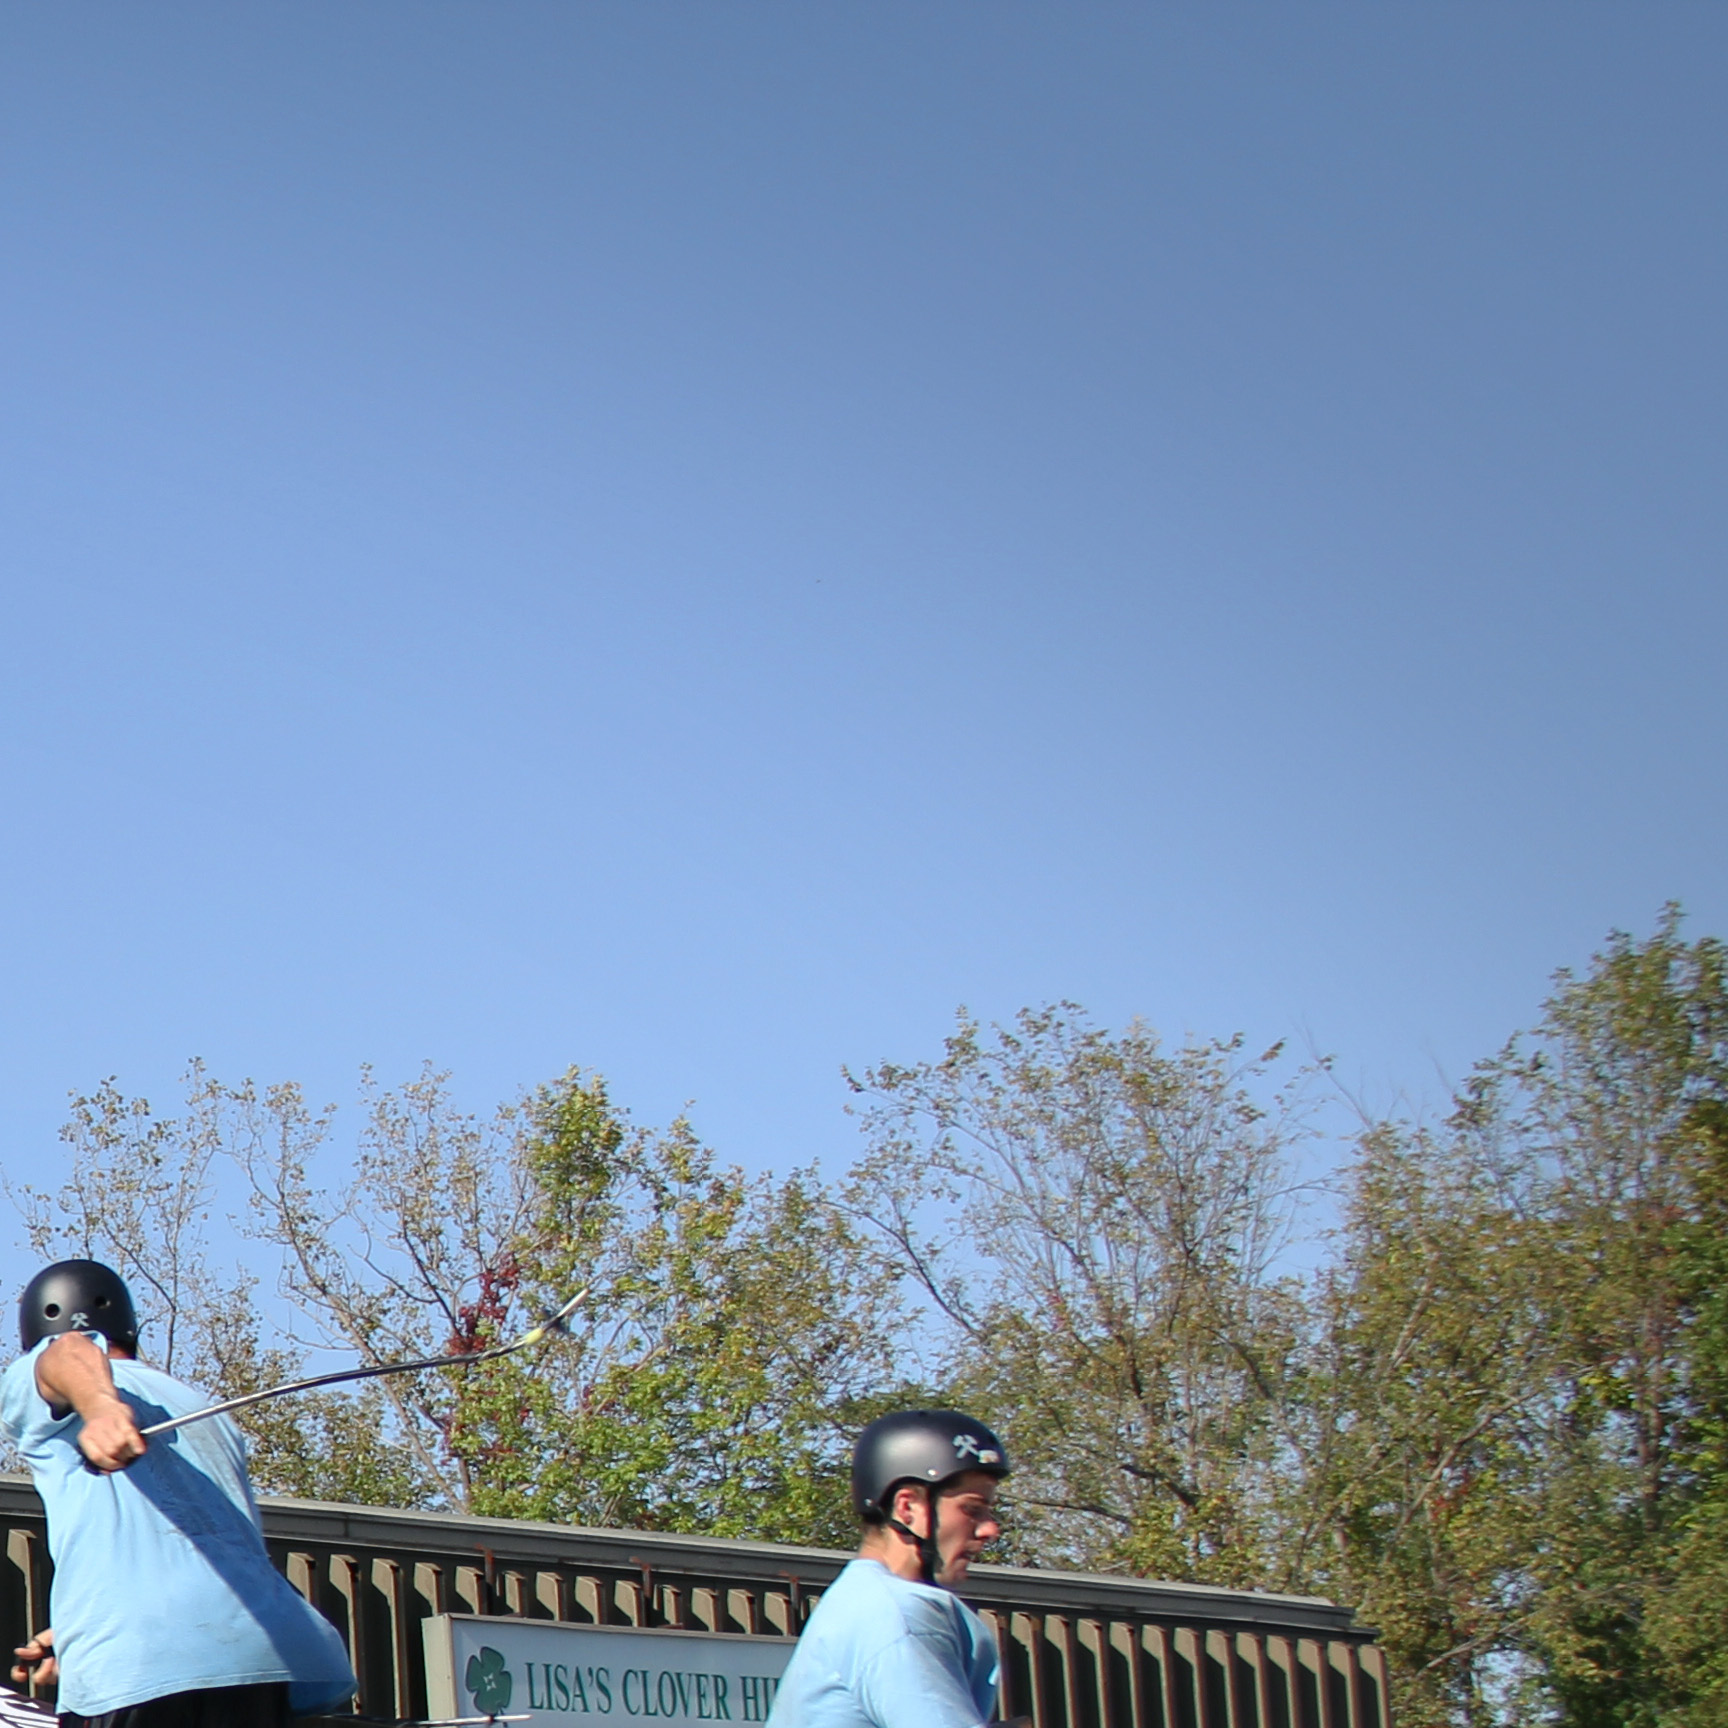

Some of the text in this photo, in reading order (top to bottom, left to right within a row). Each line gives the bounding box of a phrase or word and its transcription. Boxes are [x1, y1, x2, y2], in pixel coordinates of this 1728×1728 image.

[525, 1661, 780, 1723] LISA'S CLOVER HI
